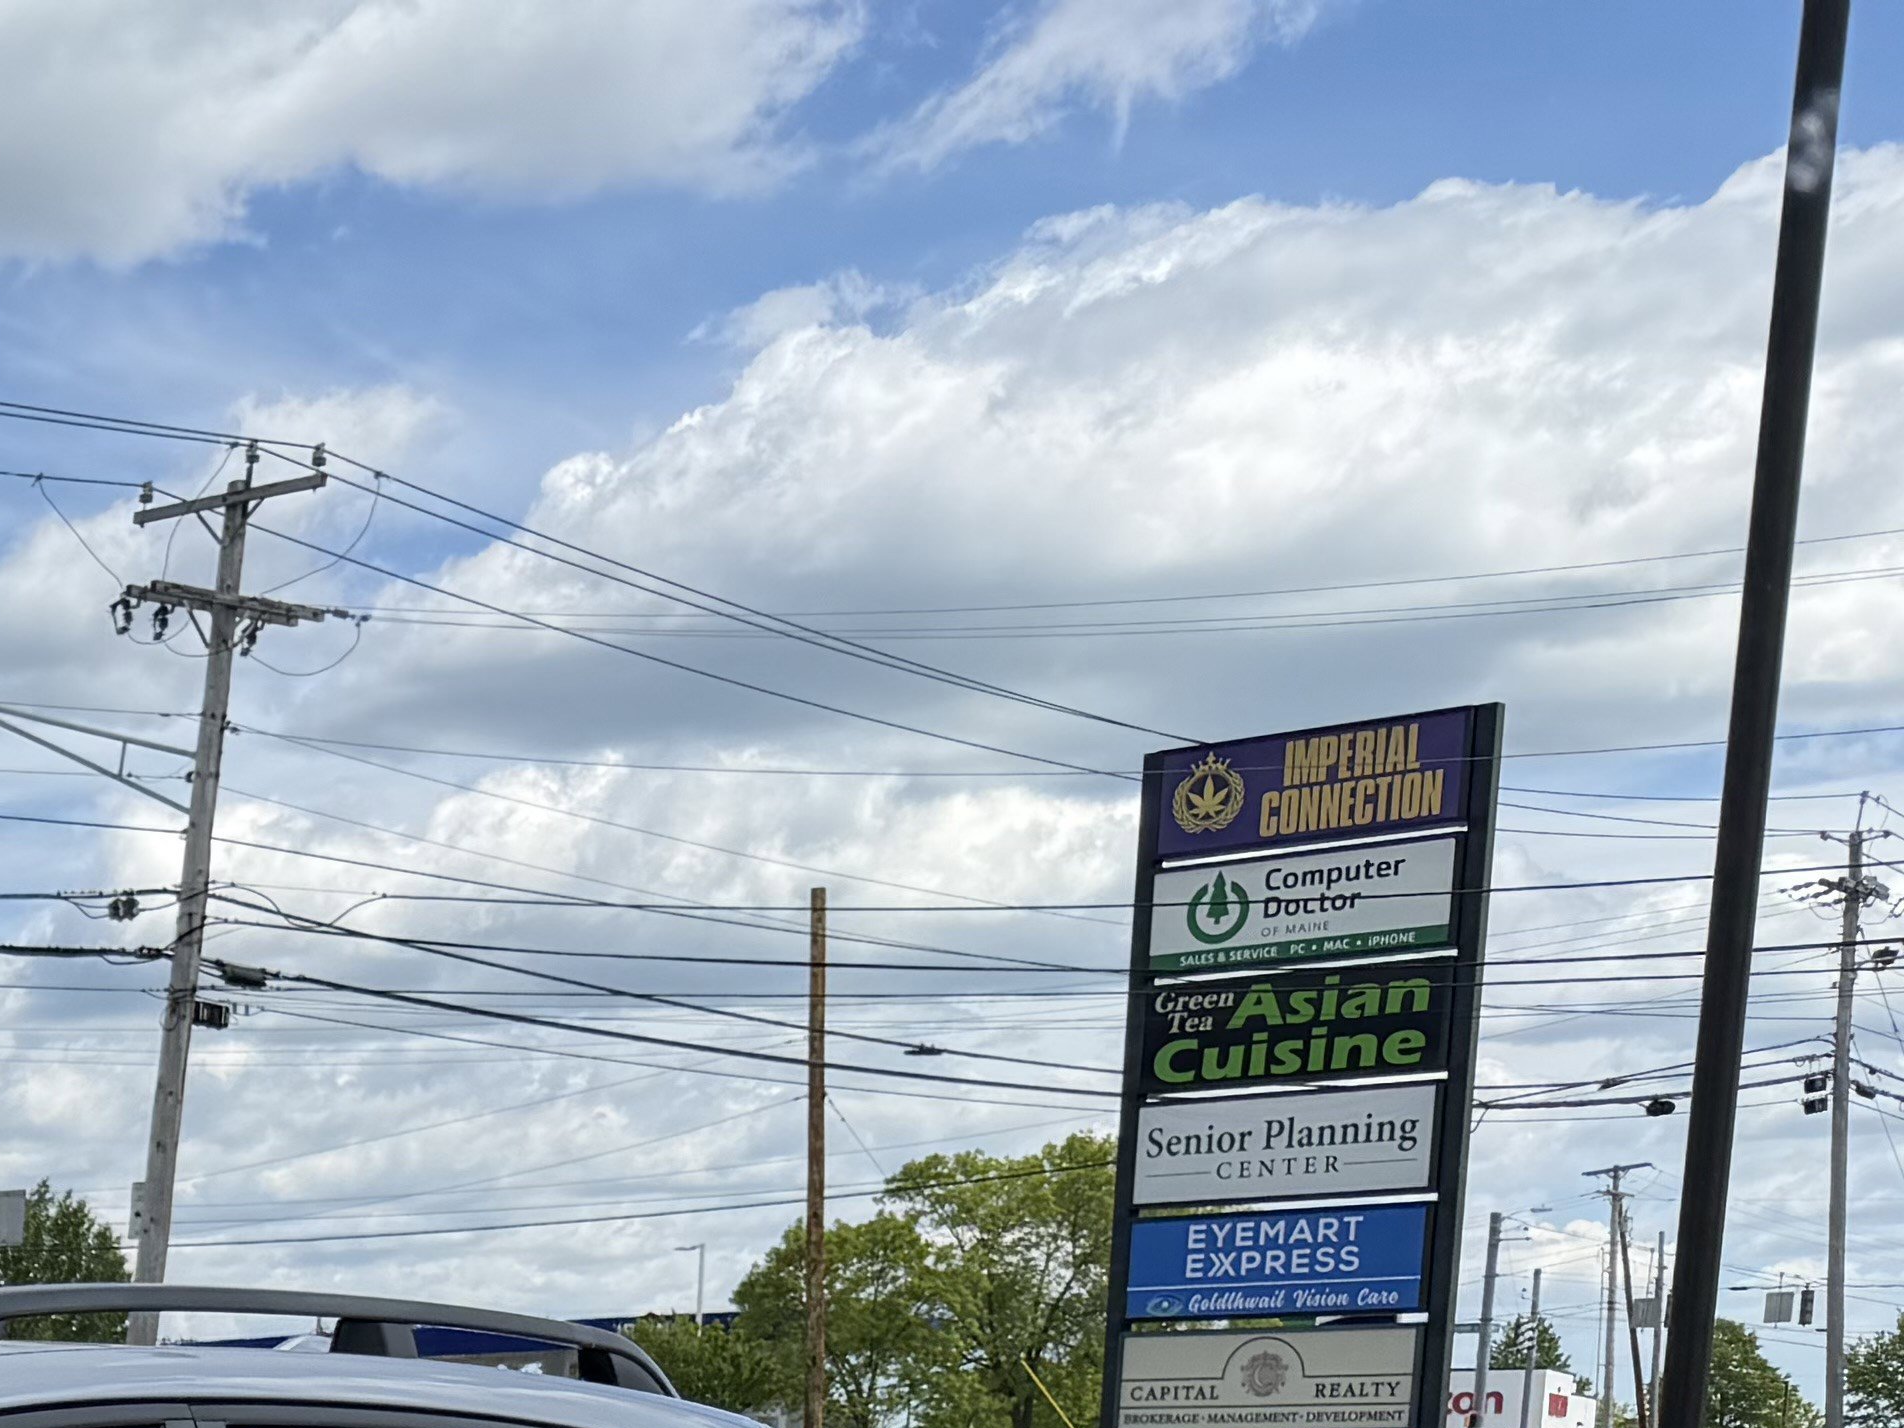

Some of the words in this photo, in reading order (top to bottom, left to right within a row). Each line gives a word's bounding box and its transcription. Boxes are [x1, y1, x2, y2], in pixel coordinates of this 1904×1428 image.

[1283, 723, 1421, 787] IMPERIAL
[1259, 769, 1444, 838] CONNECTION
[1265, 855, 1406, 891] Computer
[1263, 889, 1361, 919] Doctor
[1261, 926, 1279, 938] OF
[1285, 920, 1329, 935] MAINE
[1179, 953, 1214, 967] SALES
[1229, 946, 1277, 961] SERVICE
[1290, 943, 1306, 955] PC
[1323, 939, 1350, 951] MAC
[1155, 989, 1235, 1014] Green
[1226, 975, 1431, 1030] Asian
[1167, 1012, 1213, 1034] Tea
[1153, 1026, 1426, 1083] Cuisine
[1146, 1123, 1253, 1159] Senior
[1261, 1113, 1420, 1152] Planning
[1216, 1155, 1340, 1181] CENTER
[1188, 1216, 1364, 1249] EYEMART
[1185, 1246, 1360, 1278] EXPRESS
[1293, 1288, 1350, 1309] Vision
[1357, 1288, 1399, 1306] Care
[1130, 1384, 1220, 1402] CAPITAL
[1315, 1381, 1401, 1399] REALTY
[1123, 1413, 1200, 1426] BROKERAGE
[1206, 1411, 1299, 1424] MANAGEMENT
[1305, 1409, 1405, 1423] DEVELOPMENT
